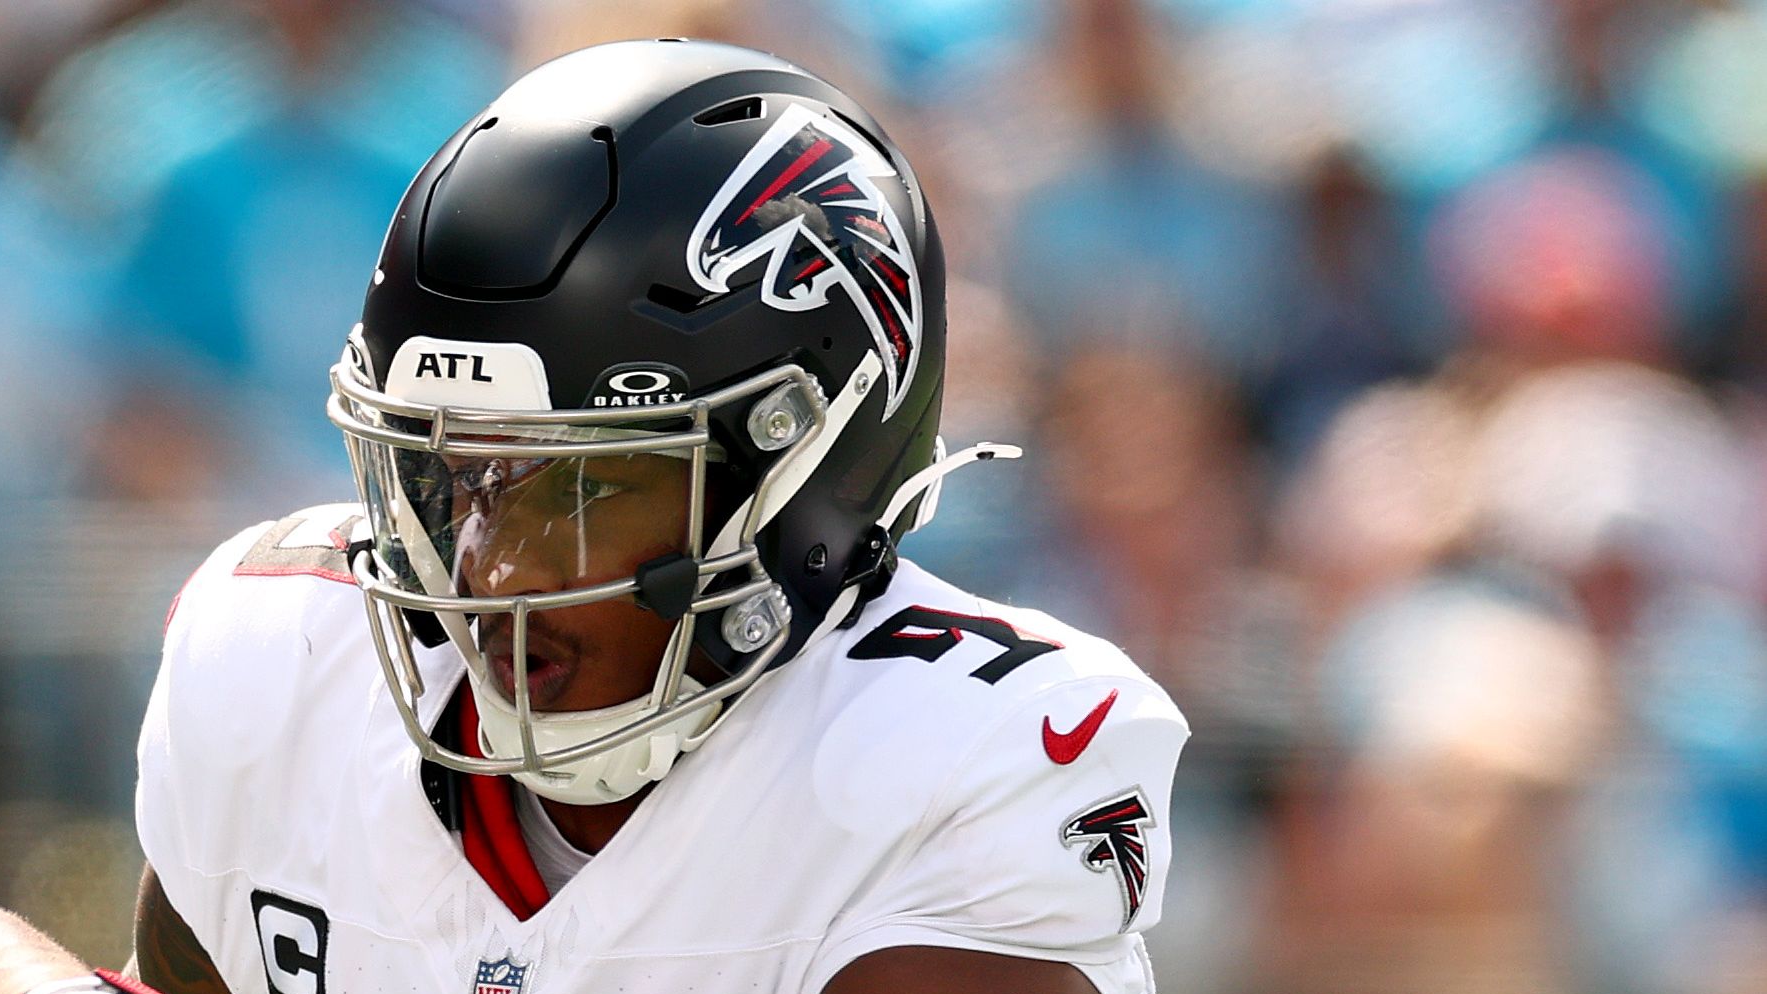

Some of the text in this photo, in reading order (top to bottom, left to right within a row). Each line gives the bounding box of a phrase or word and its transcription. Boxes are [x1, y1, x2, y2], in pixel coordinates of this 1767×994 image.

[415, 353, 492, 382] ATL
[594, 393, 686, 407] OAKLEY
[847, 605, 1065, 686] 9
